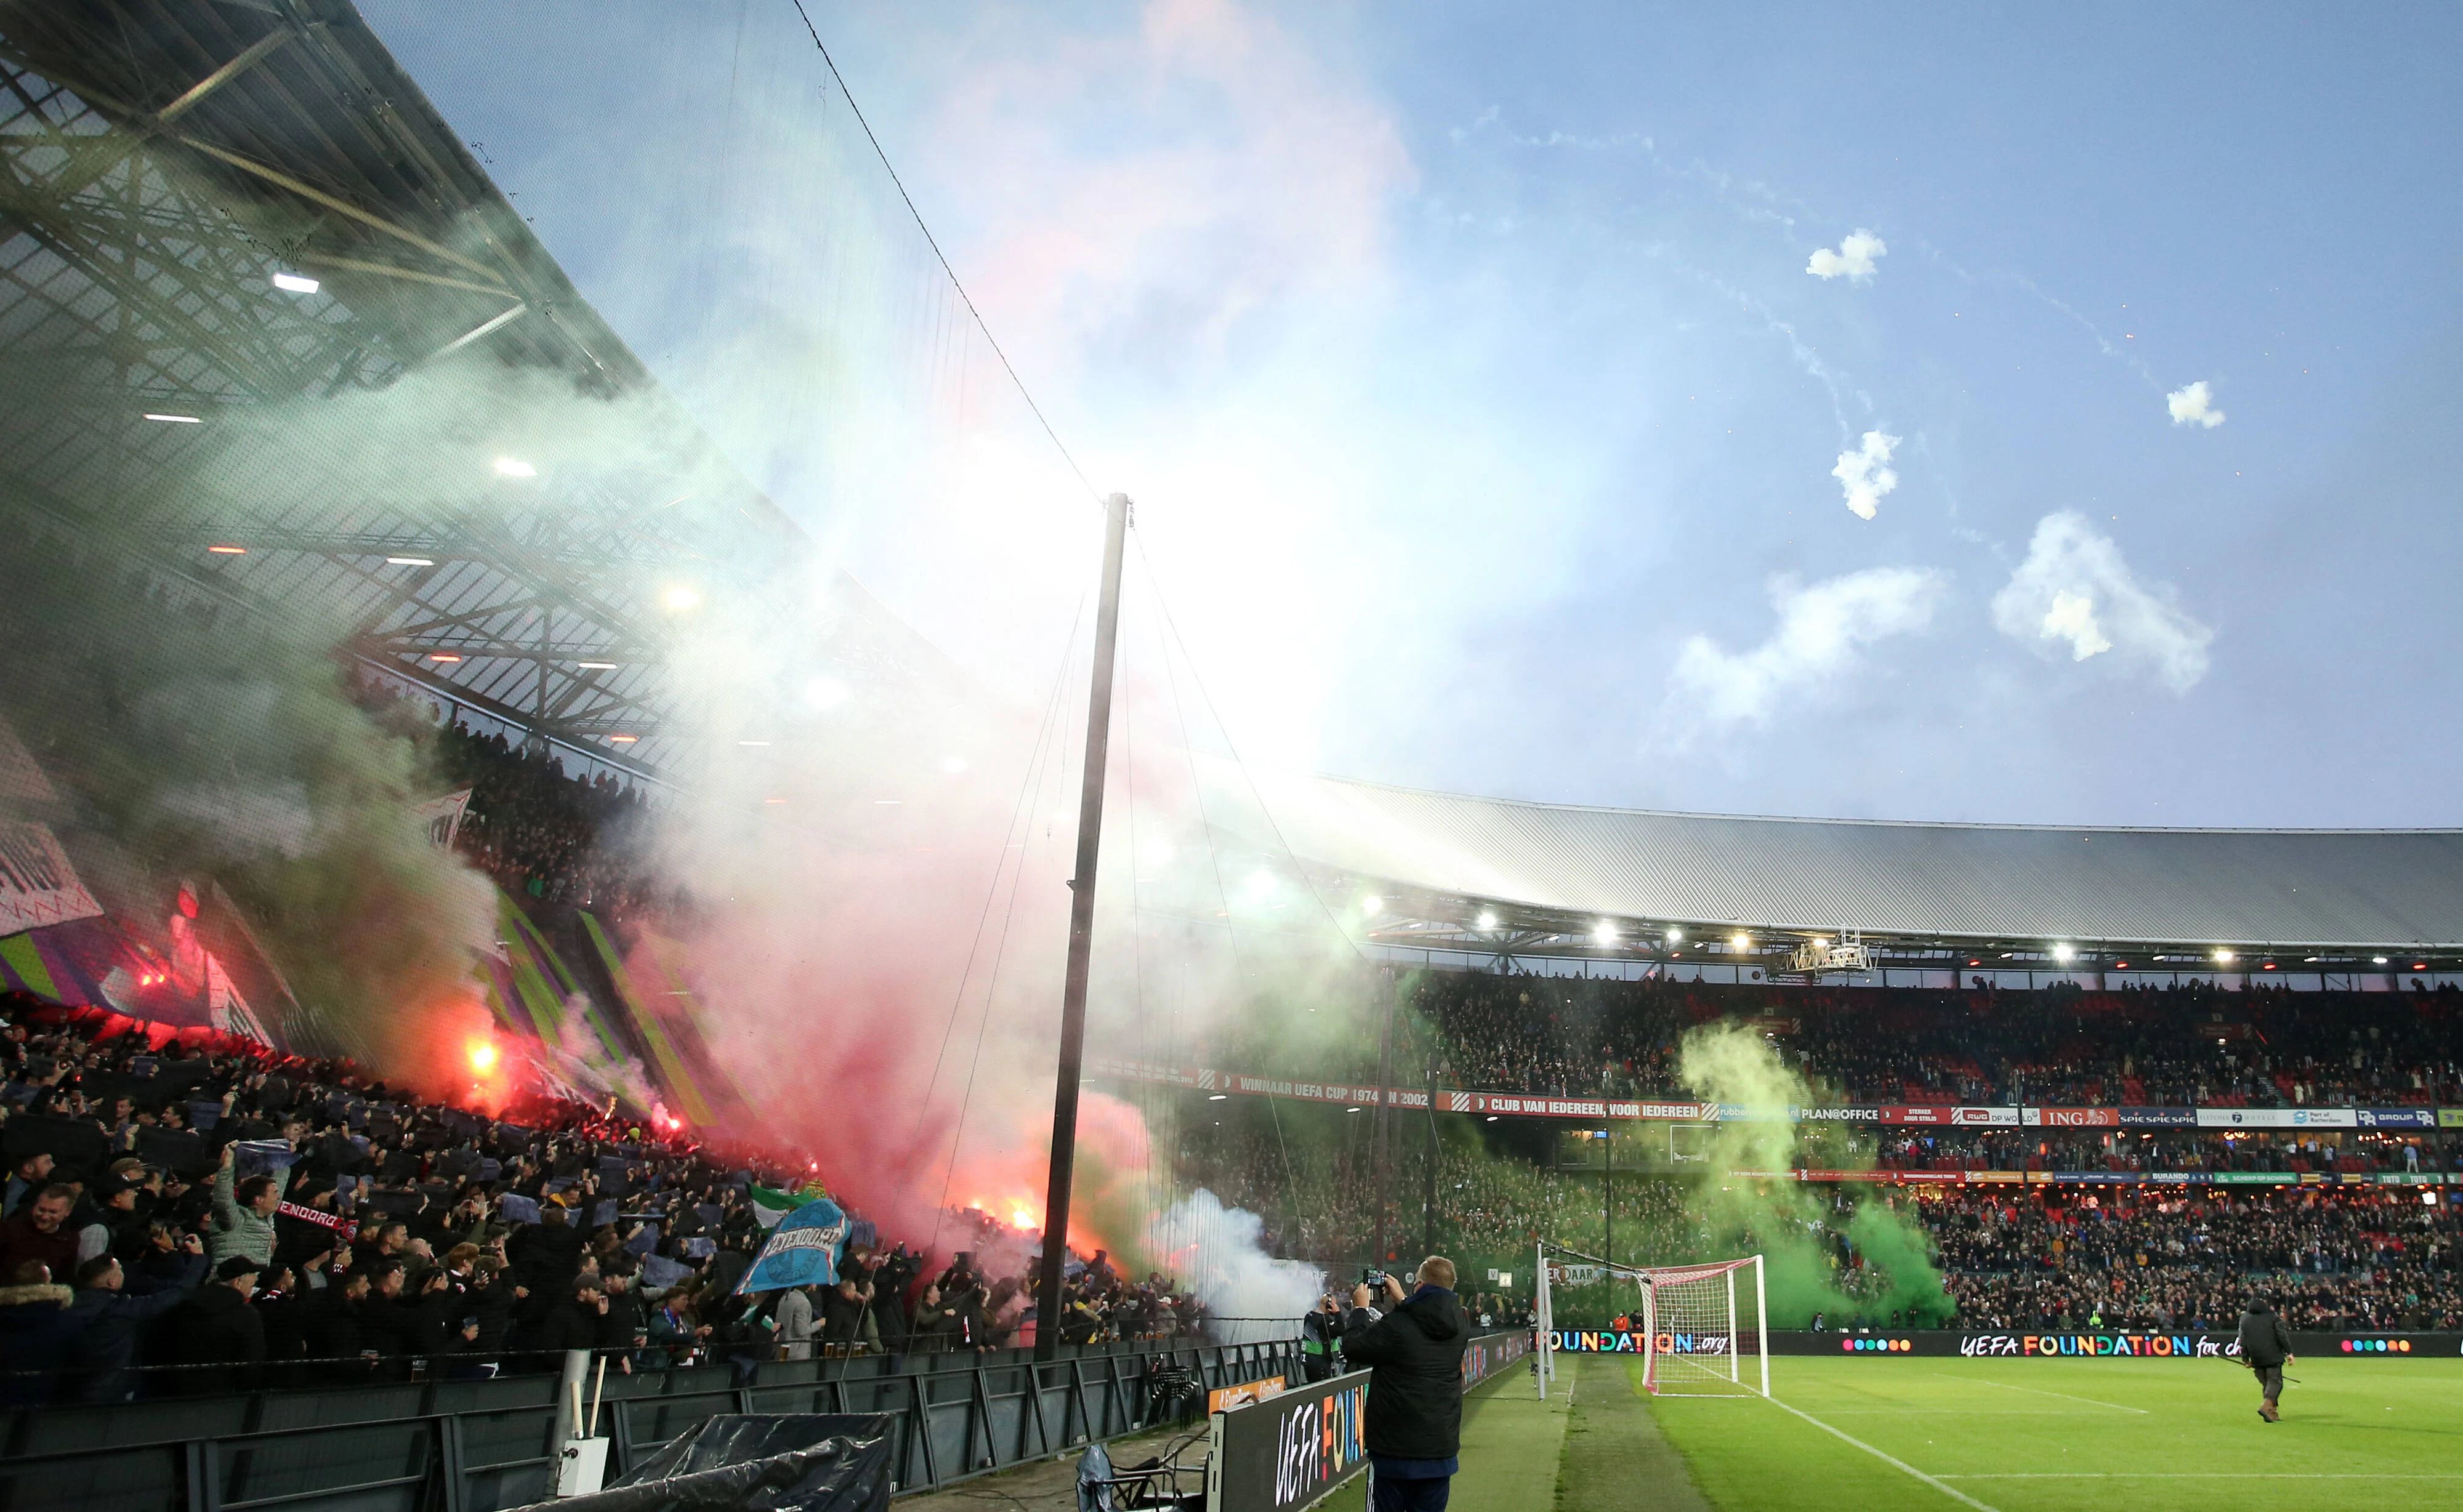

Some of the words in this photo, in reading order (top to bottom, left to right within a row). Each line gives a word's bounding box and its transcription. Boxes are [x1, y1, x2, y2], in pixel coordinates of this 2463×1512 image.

[1240, 1077, 1292, 1095] WINNAAR
[1295, 1084, 1323, 1098] UEFA
[1326, 1087, 1348, 1100] CUP
[1352, 1089, 1379, 1103] 1974
[1388, 1092, 1397, 1103] N
[1400, 1093, 1429, 1106] 2002
[1491, 1098, 1520, 1112] CLUB
[1523, 1100, 1546, 1113] VAN
[1549, 1101, 1606, 1117] IEDEREEN,
[1608, 1103, 1639, 1116] VOOR
[1642, 1103, 1698, 1118] IEDEREEN
[1802, 1109, 1879, 1120] PLAN@OFFICE
[2049, 1112, 2084, 1126] ING
[2382, 1175, 2400, 1183] TOTO
[2409, 1175, 2427, 1183] TOTO
[1536, 1331, 1728, 1355] OUNDATON.org
[1960, 1335, 2019, 1356] UEFA
[2023, 1335, 2190, 1356] FOUNDATION
[2196, 1335, 2221, 1358] for
[2225, 1337, 2242, 1356] ch
[1275, 1402, 1321, 1507] UEFA
[1322, 1383, 1369, 1481] FOUN
